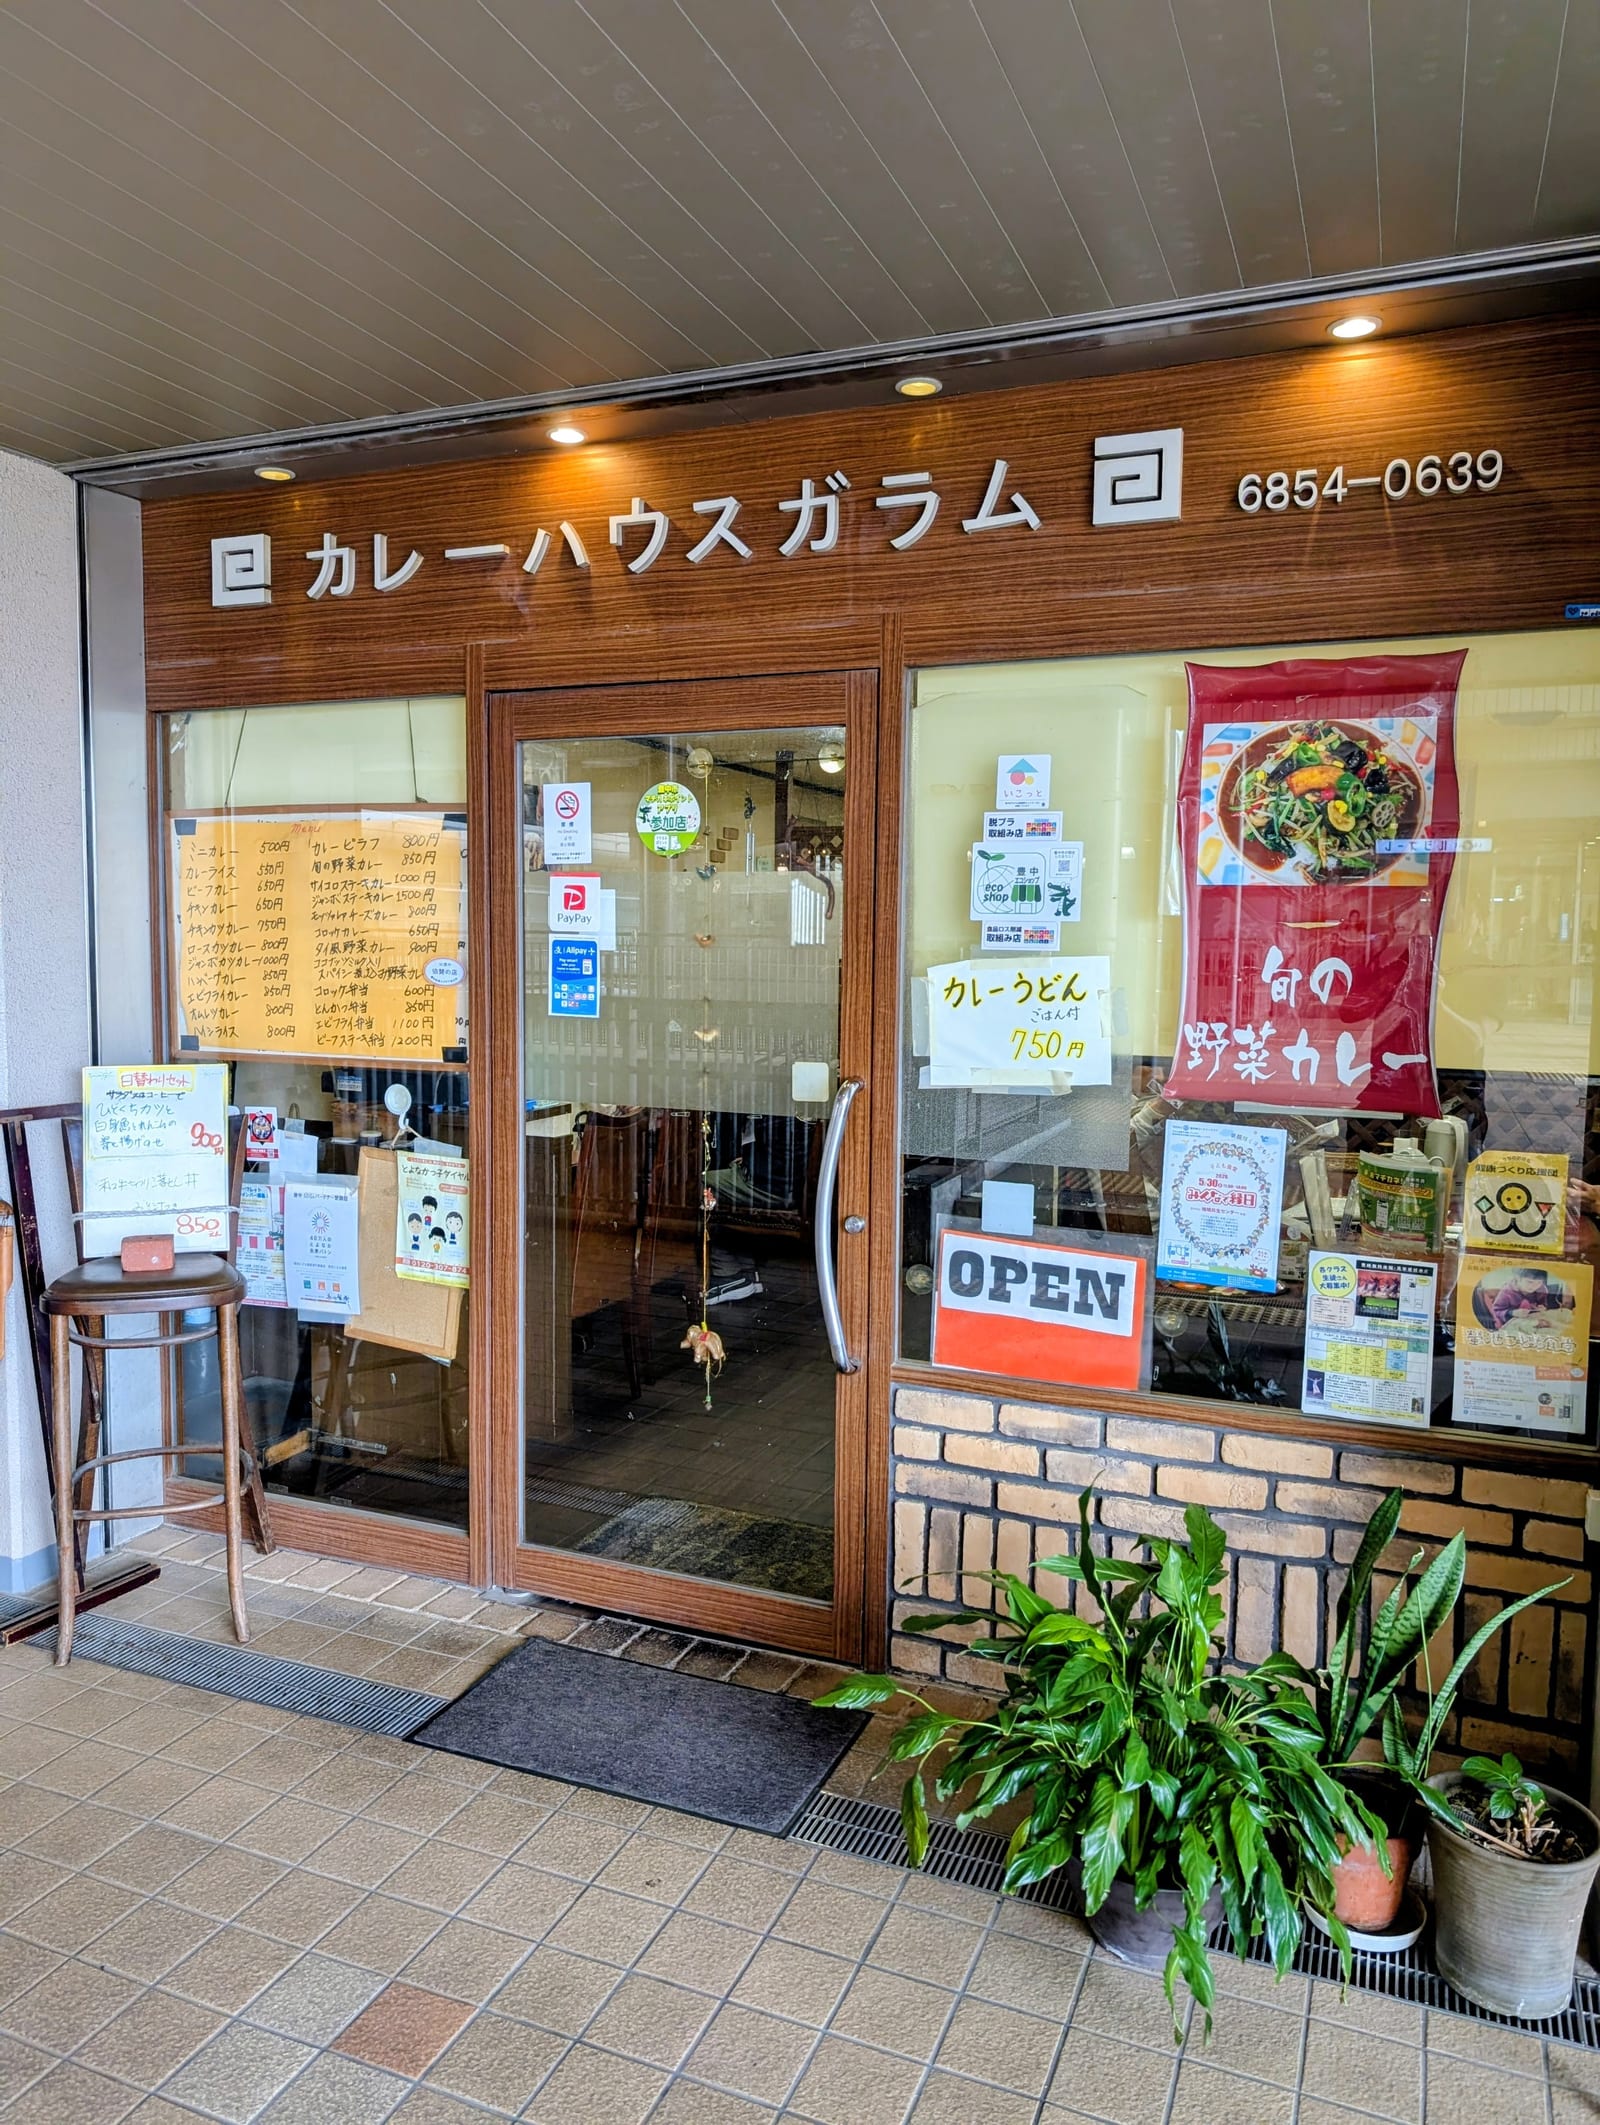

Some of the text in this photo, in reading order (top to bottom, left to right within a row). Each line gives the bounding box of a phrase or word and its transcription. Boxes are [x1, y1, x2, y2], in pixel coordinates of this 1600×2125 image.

[1237, 449, 1505, 515] 6854-0639
[305, 458, 1042, 600] カレーハウスガラム
[1004, 789, 1042, 798] いこっと
[651, 816, 687, 831] 参加店
[988, 829, 1023, 838] 取組み店
[260, 840, 290, 854] 500円
[311, 832, 440, 857] カレーピラフ 800円
[312, 850, 437, 875] 旬の野菜カレー 850円
[185, 861, 285, 880] カレーライス 550円
[187, 879, 285, 897] ビーフカレー 650円
[310, 870, 436, 893] サイコロステーキカレー 1000円
[985, 883, 1004, 892] eco
[396, 888, 435, 903] 1500円
[983, 891, 1009, 904] shop
[255, 898, 284, 912] 650円
[257, 917, 287, 932] 750円
[557, 913, 592, 924] PayPay
[408, 922, 440, 937] 650円
[261, 937, 289, 951] 800円
[986, 933, 1021, 942] 取組み店
[408, 941, 438, 956] 900円
[262, 969, 288, 981] 850円
[1260, 944, 1354, 1008] 旬の
[263, 984, 291, 998] 850円
[313, 982, 436, 999] コロッケ弁当 600円
[943, 971, 1087, 1009] カレーうどん
[265, 1003, 294, 1017] 800円
[314, 1000, 369, 1015] とんかつ弁当
[1030, 1006, 1081, 1024] ごはん付
[266, 1025, 296, 1039] 800円
[391, 1034, 433, 1047] 1200円
[1183, 1019, 1429, 1088] 野菜カレー
[120, 1072, 191, 1088] 日替わりセット
[401, 1165, 471, 1182] とよなかっ子ダイヤル
[948, 1249, 1126, 1321] OPEN
